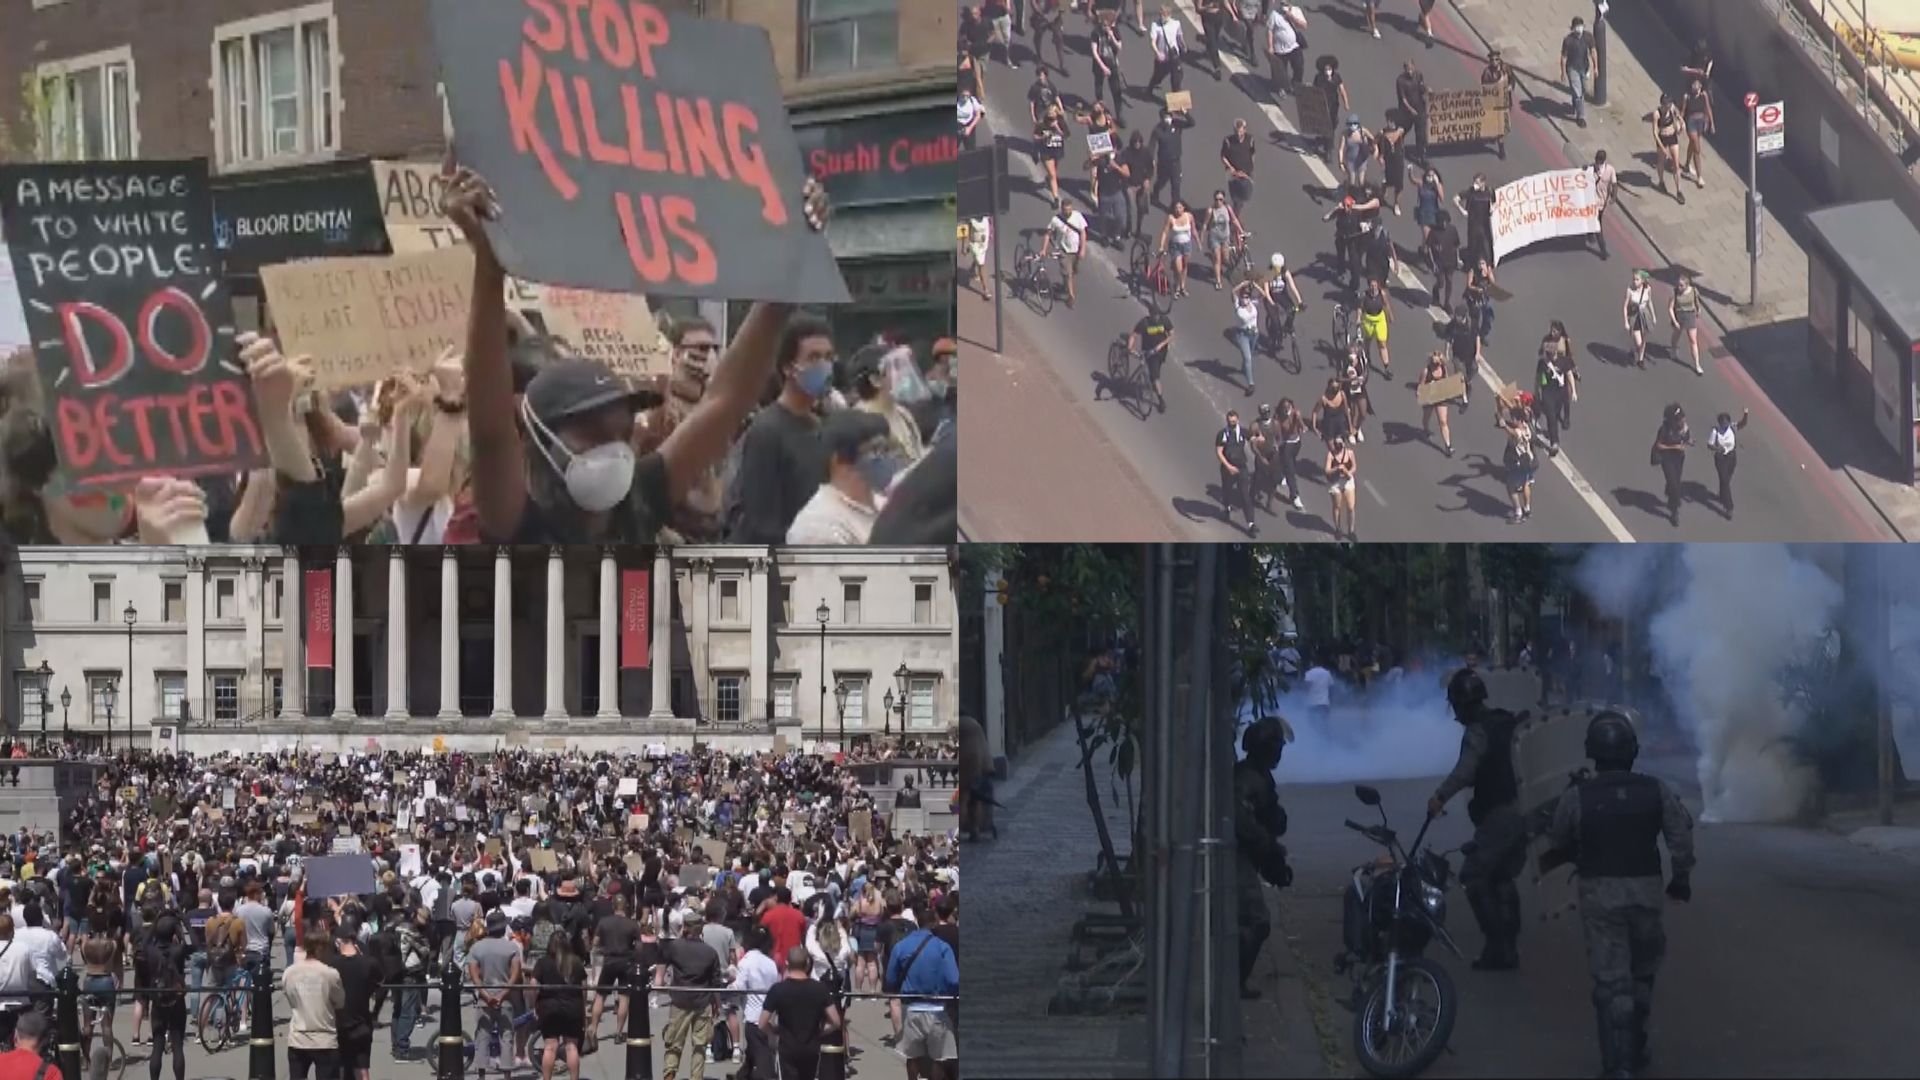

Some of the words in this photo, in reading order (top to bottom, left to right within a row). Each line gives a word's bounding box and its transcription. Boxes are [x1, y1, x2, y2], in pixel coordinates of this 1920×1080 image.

[523, 0, 670, 79] STOP
[1430, 108, 1486, 123] EXPLAINING
[1430, 124, 1458, 136] BLACK
[499, 42, 788, 226] KILLING
[810, 141, 880, 180] Sushi
[17, 178, 41, 205] A
[49, 174, 188, 203] MESSAGE
[1498, 181, 1529, 206] ACK
[1533, 174, 1588, 195] LIVES
[1498, 222, 1513, 236] UK
[1523, 212, 1543, 223] NOT
[1547, 204, 1598, 219] INNOCENT
[1499, 194, 1576, 220] MATTER
[32, 216, 77, 242] TO
[94, 211, 188, 236] WHITE
[236, 213, 290, 236] BLOOR
[615, 193, 718, 284] US
[29, 243, 212, 286] PEOPLE:
[60, 286, 212, 388] DO
[58, 381, 262, 468] BETTER
